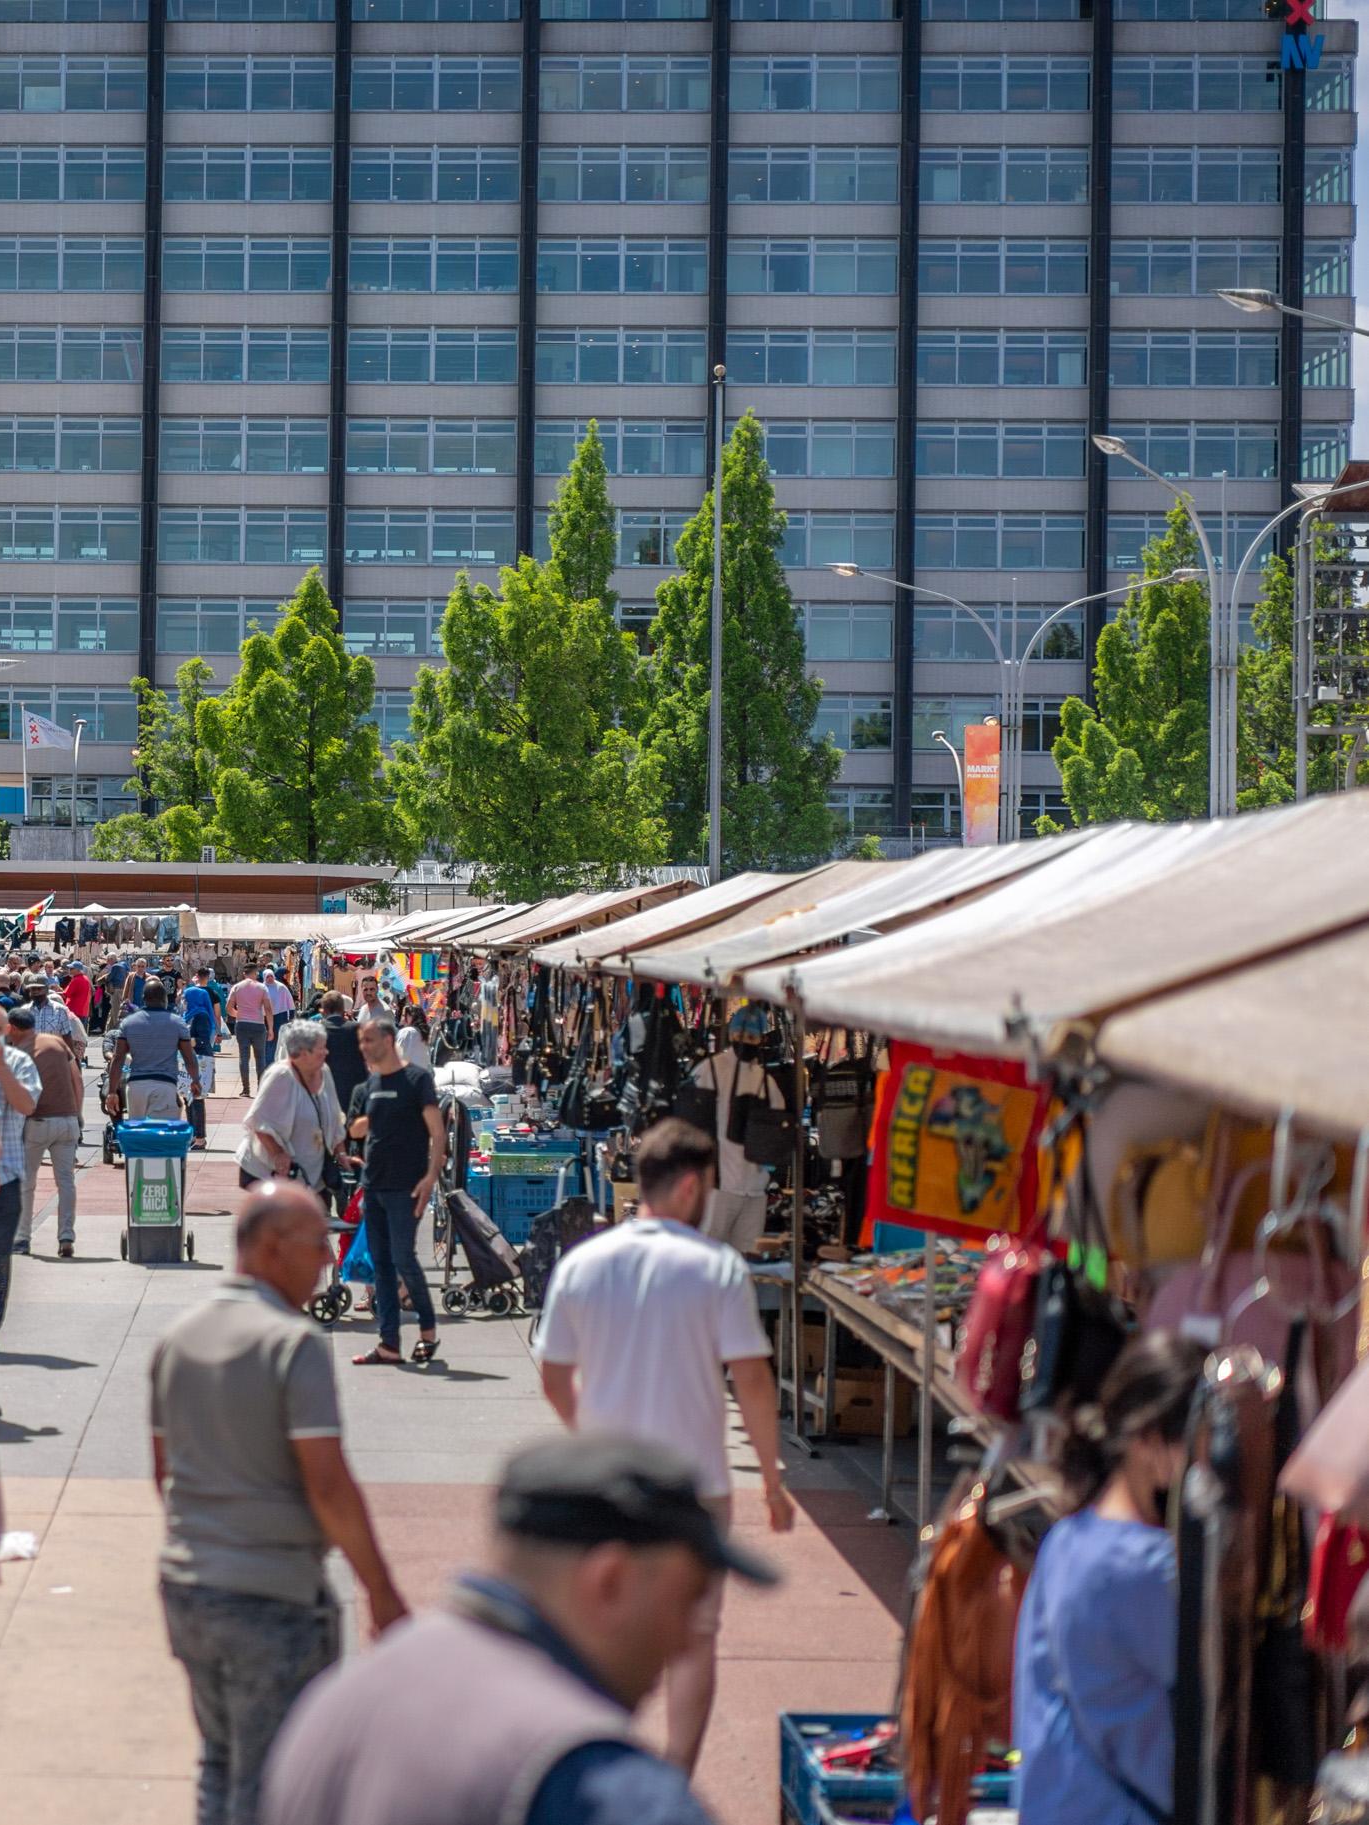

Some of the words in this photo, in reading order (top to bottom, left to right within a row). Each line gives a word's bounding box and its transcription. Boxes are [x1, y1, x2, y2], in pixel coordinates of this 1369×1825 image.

[221, 943, 230, 956] 5
[892, 1070, 931, 1206] AFRICA
[142, 1184, 167, 1197] ZERO
[142, 1198, 167, 1210] MICA
